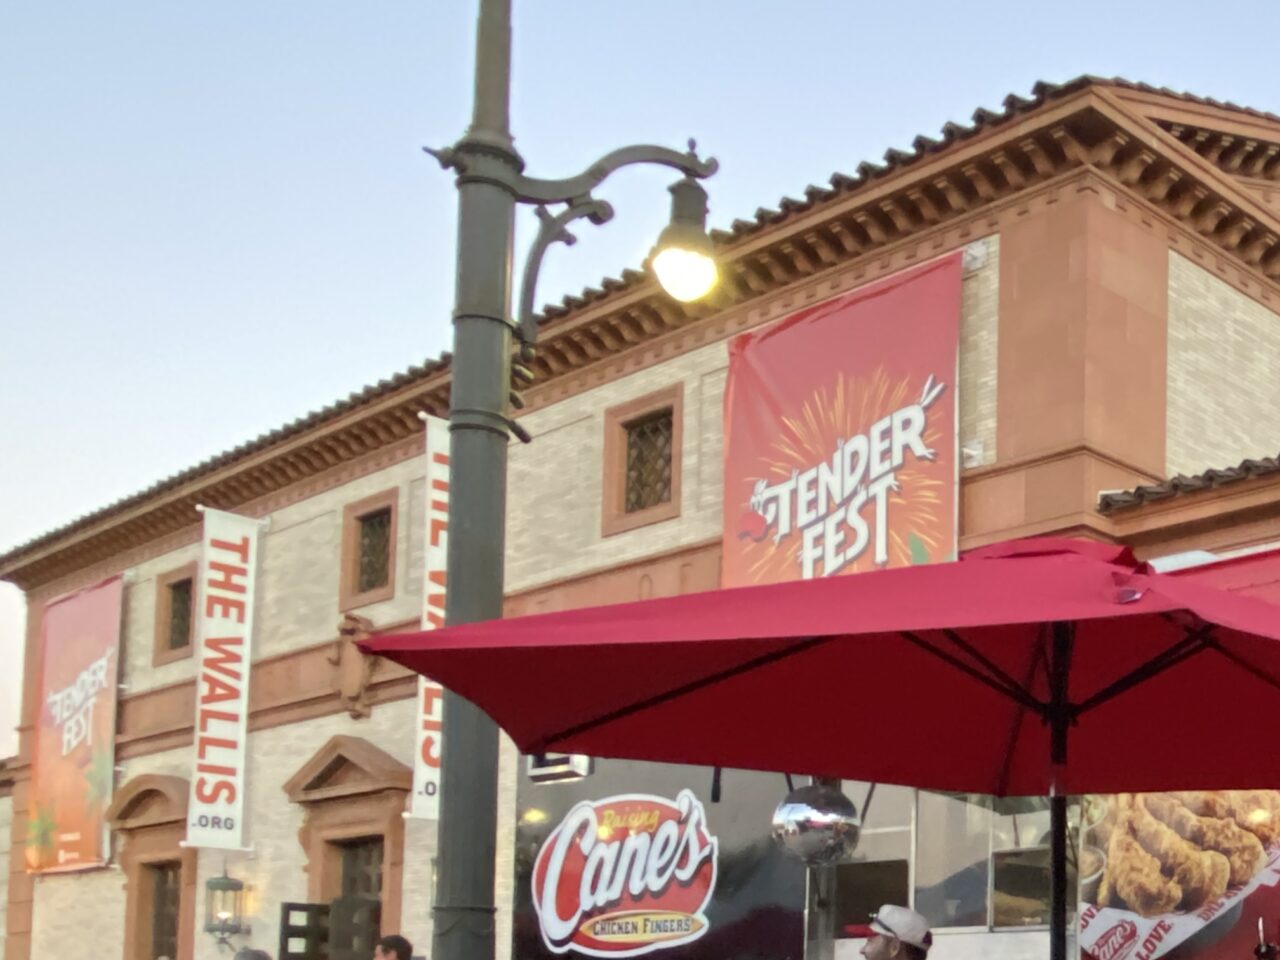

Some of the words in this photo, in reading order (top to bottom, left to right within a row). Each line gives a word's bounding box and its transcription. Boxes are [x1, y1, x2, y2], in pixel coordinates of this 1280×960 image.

[751, 388, 937, 543] TENDER
[798, 474, 901, 580] FEST
[205, 537, 250, 624] THE
[195, 636, 244, 806] WALLIS
[191, 814, 235, 832] .ORG
[541, 794, 713, 942] Cane's
